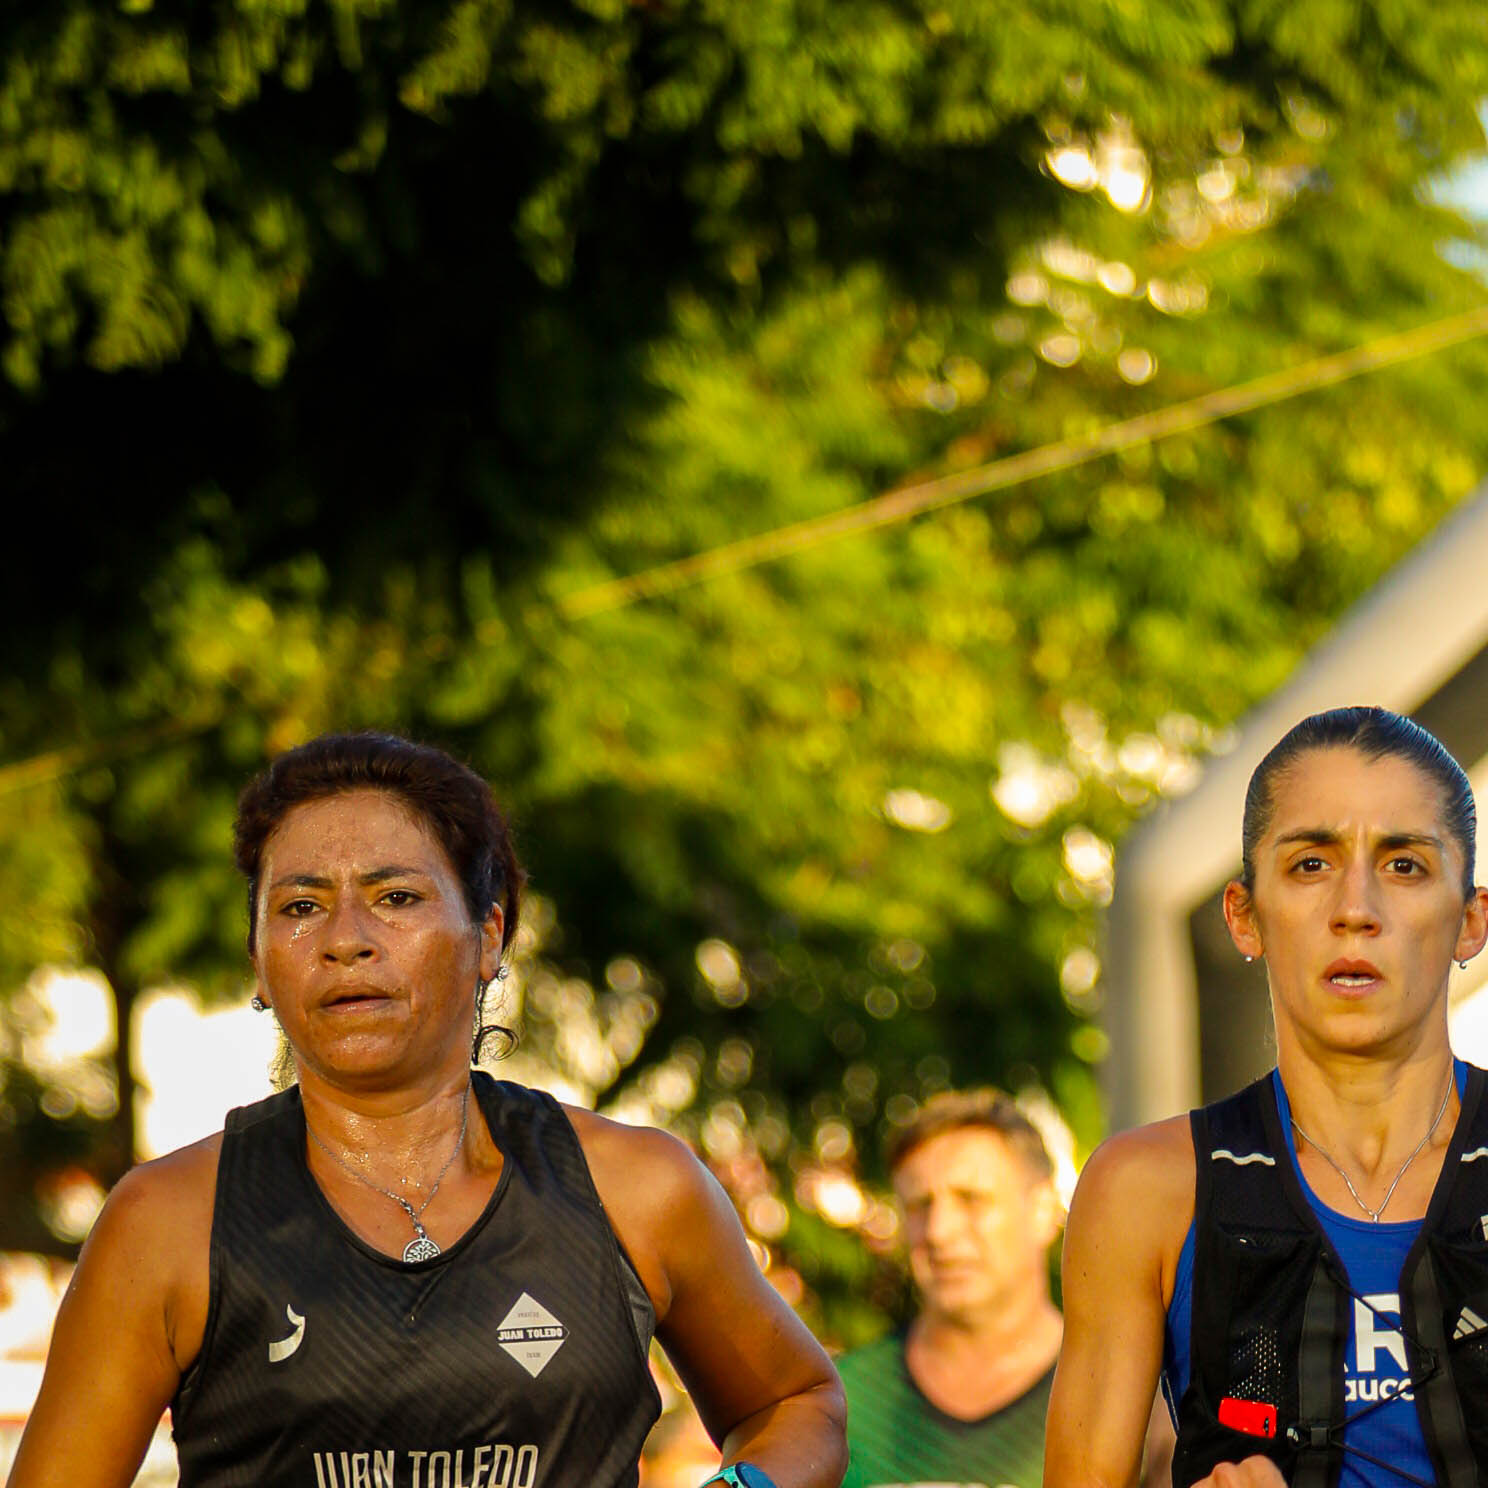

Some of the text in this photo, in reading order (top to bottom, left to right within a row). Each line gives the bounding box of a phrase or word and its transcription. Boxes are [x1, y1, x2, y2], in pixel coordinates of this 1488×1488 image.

[497, 1327, 563, 1341] JUAN TOLEDO
[1344, 1378, 1415, 1402] auco
